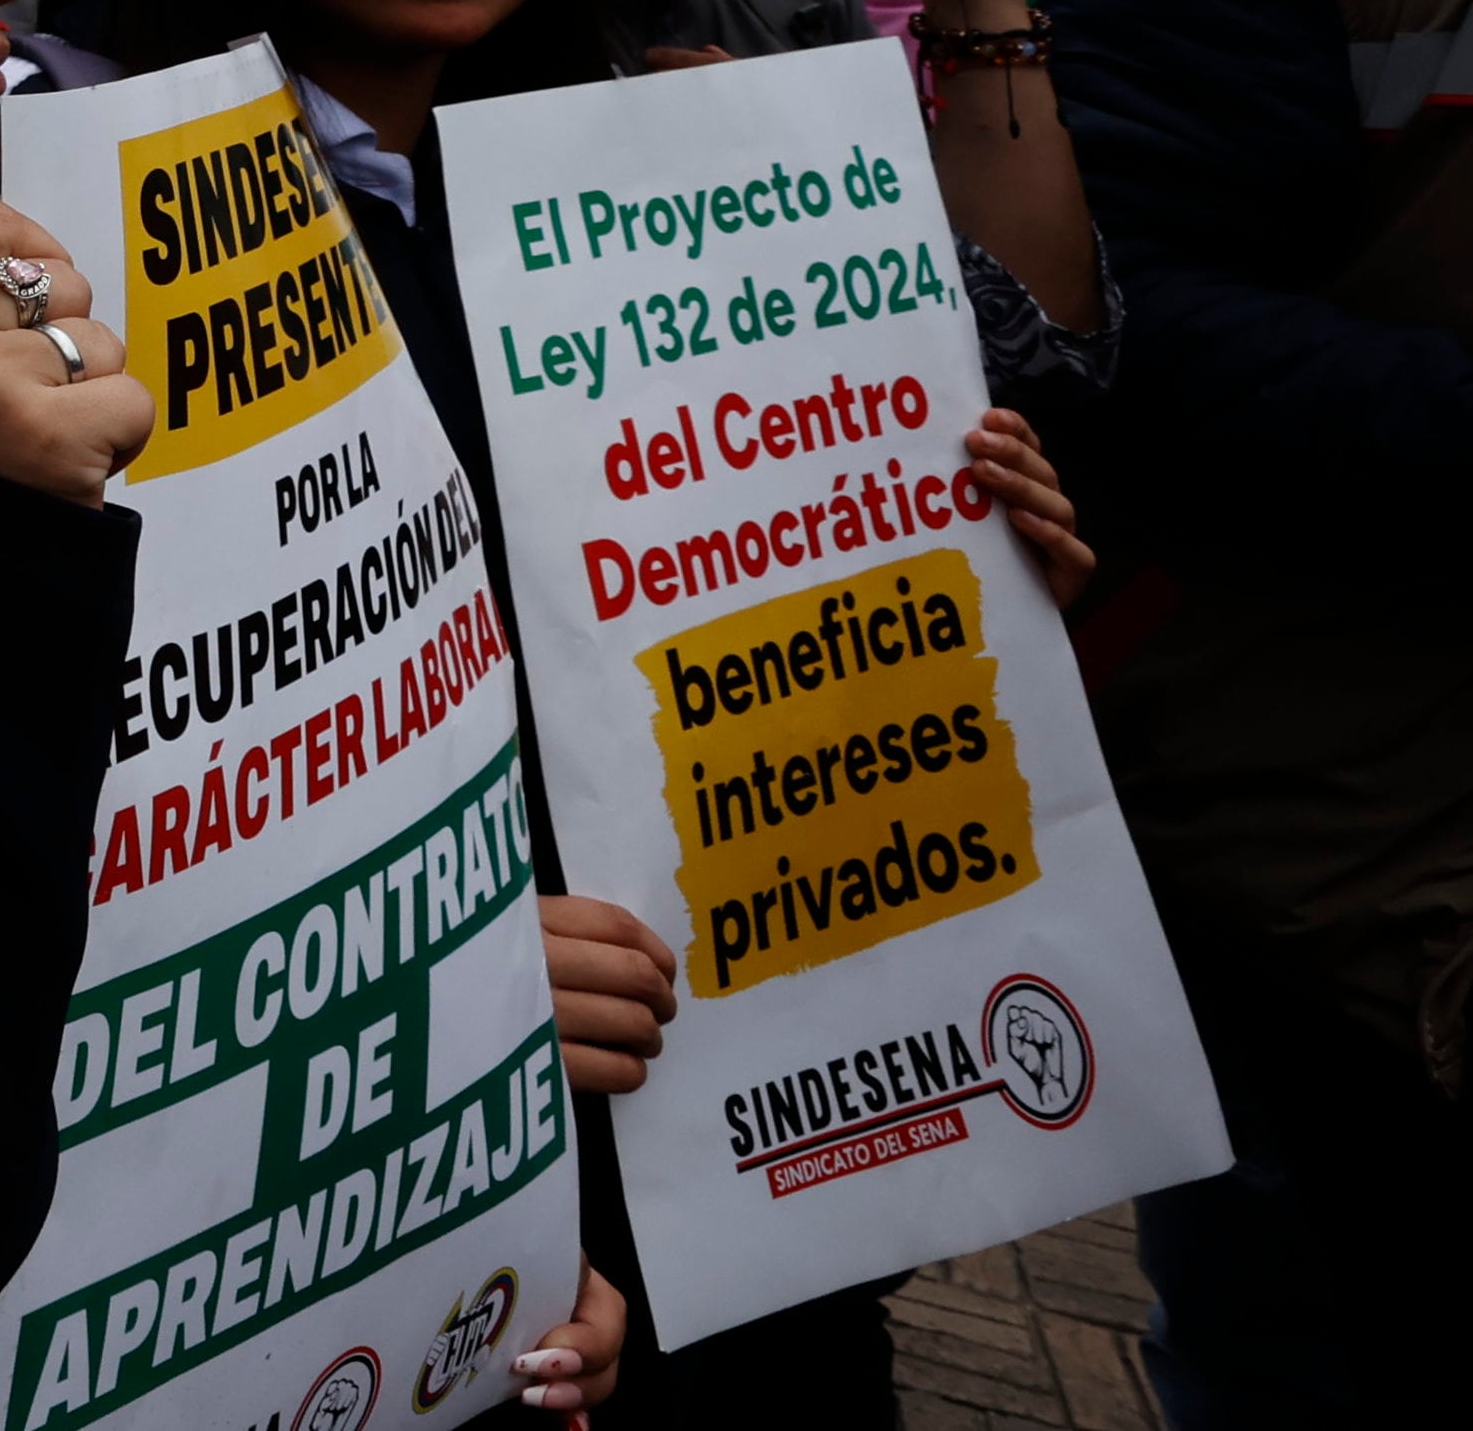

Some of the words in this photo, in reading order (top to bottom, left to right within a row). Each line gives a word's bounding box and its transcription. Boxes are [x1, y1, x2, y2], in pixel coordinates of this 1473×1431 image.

[139, 117, 339, 287] SINDESE
[511, 198, 571, 272] El
[578, 161, 832, 260] Proyecto
[843, 144, 903, 210] de
[500, 324, 608, 401] Ley
[619, 286, 719, 369] 132
[727, 275, 798, 346] de
[805, 241, 959, 331] 2024,
[275, 452, 343, 549] POR
[343, 430, 381, 509] LA
[603, 405, 706, 502] del
[713, 373, 930, 471] Centro
[106, 498, 439, 767] ECUPERACIÓN
[433, 466, 482, 576] DEL
[580, 457, 994, 623] Democrático
[665, 575, 967, 731] beneficia
[88, 691, 368, 908] ARÁCTER
[690, 701, 990, 849] intereses
[59, 966, 218, 1133] DEL
[234, 756, 533, 1050] CONTRATO
[708, 819, 1019, 990] privados.
[298, 1011, 399, 1163] DE
[723, 1023, 982, 1160] SINDESENA
[773, 1142, 871, 1193] SINDICATO
[872, 1132, 906, 1166] DEL
[907, 1113, 961, 1157] SENA
[25, 1040, 557, 1431] APRENDIZAJE
